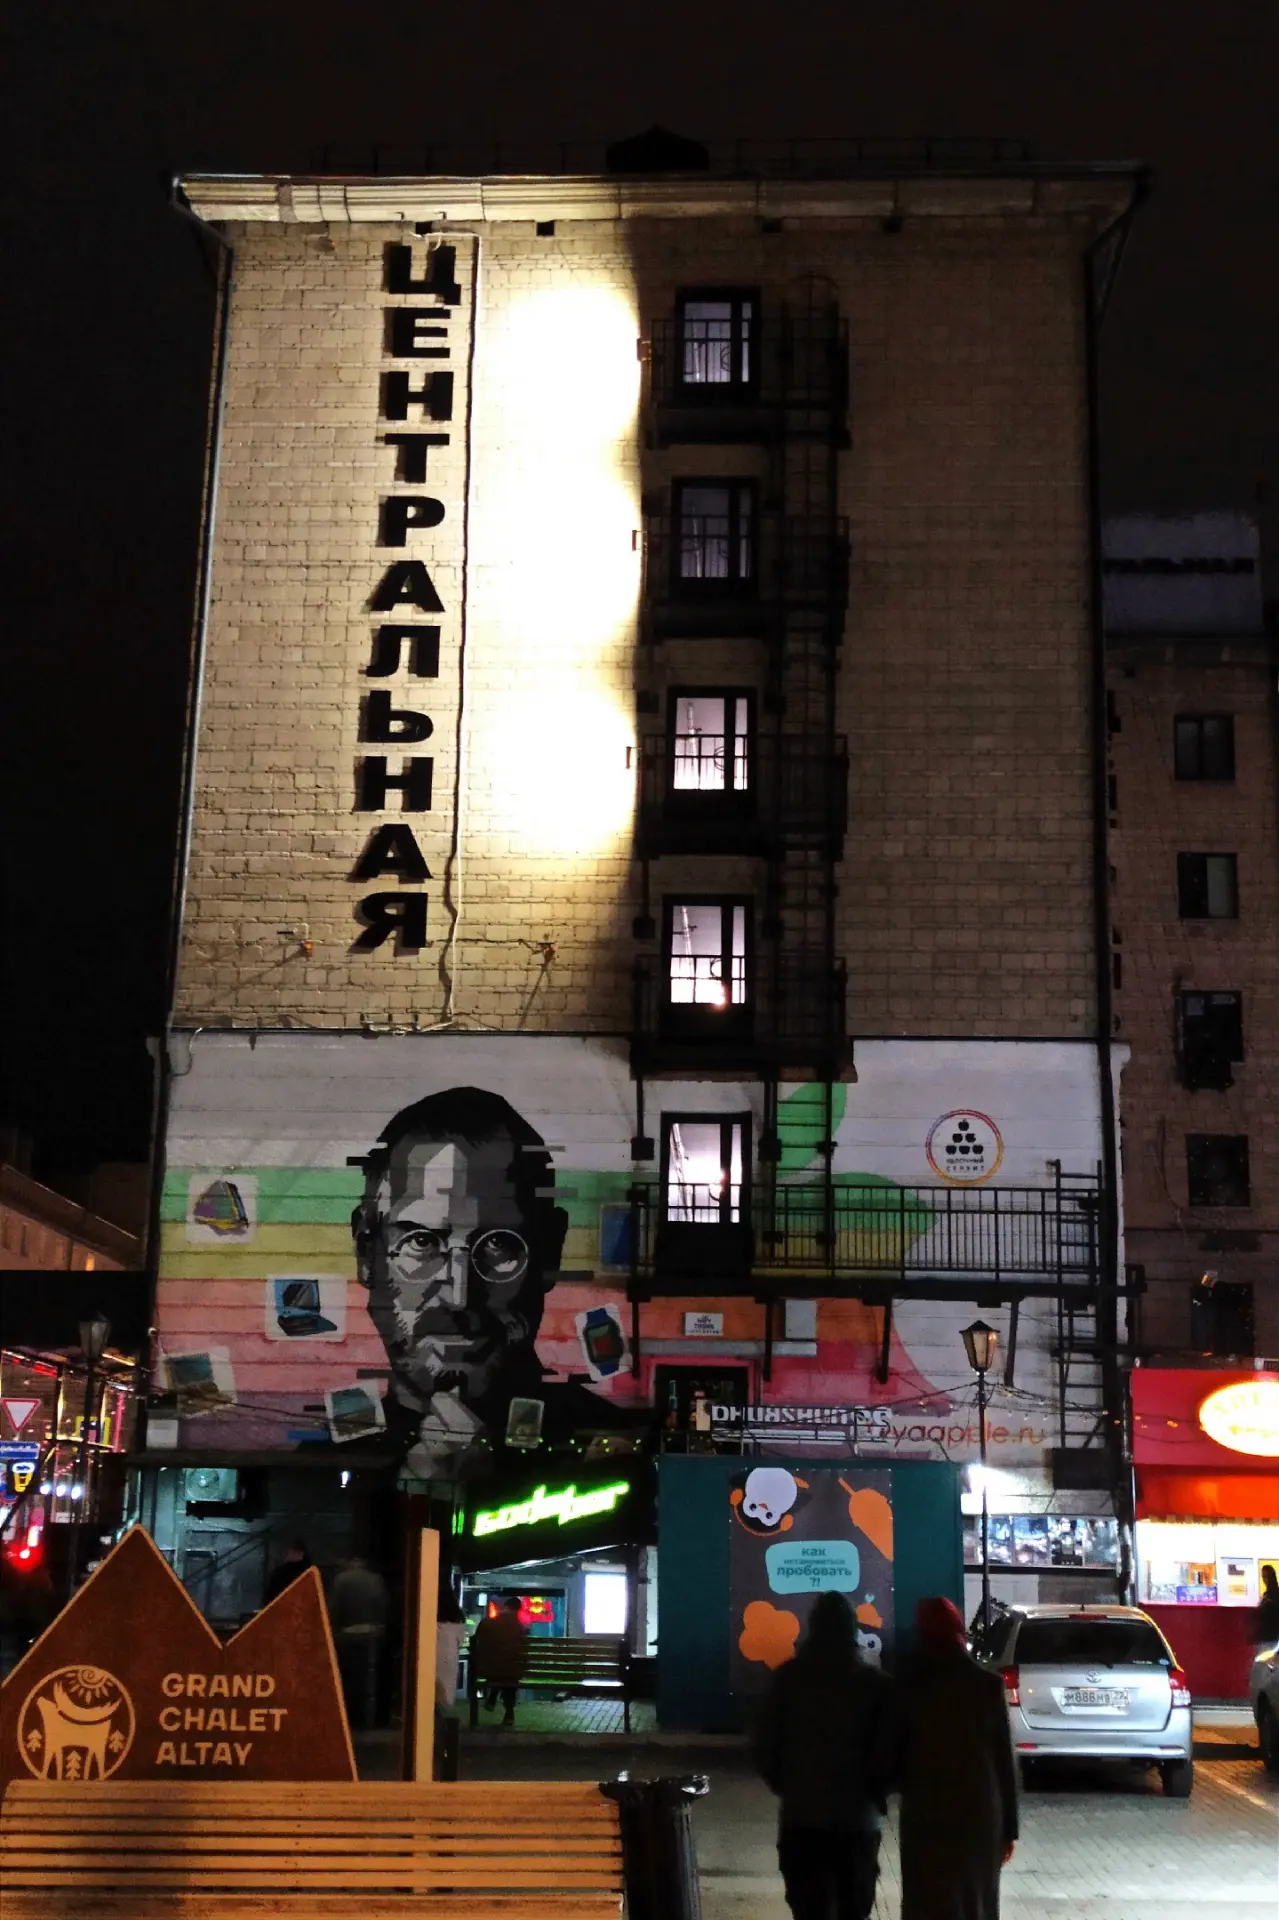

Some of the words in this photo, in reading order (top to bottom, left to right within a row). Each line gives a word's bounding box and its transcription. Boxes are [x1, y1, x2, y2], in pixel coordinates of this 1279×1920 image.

[355, 243, 462, 956] ЦЕНТРАЛЬНАЯ
[801, 1548, 828, 1556] как
[776, 1565, 853, 1578] пробовать
[161, 1672, 276, 1698] GRAND
[159, 1706, 289, 1732] CHALET
[155, 1741, 253, 1766] ALTAY
